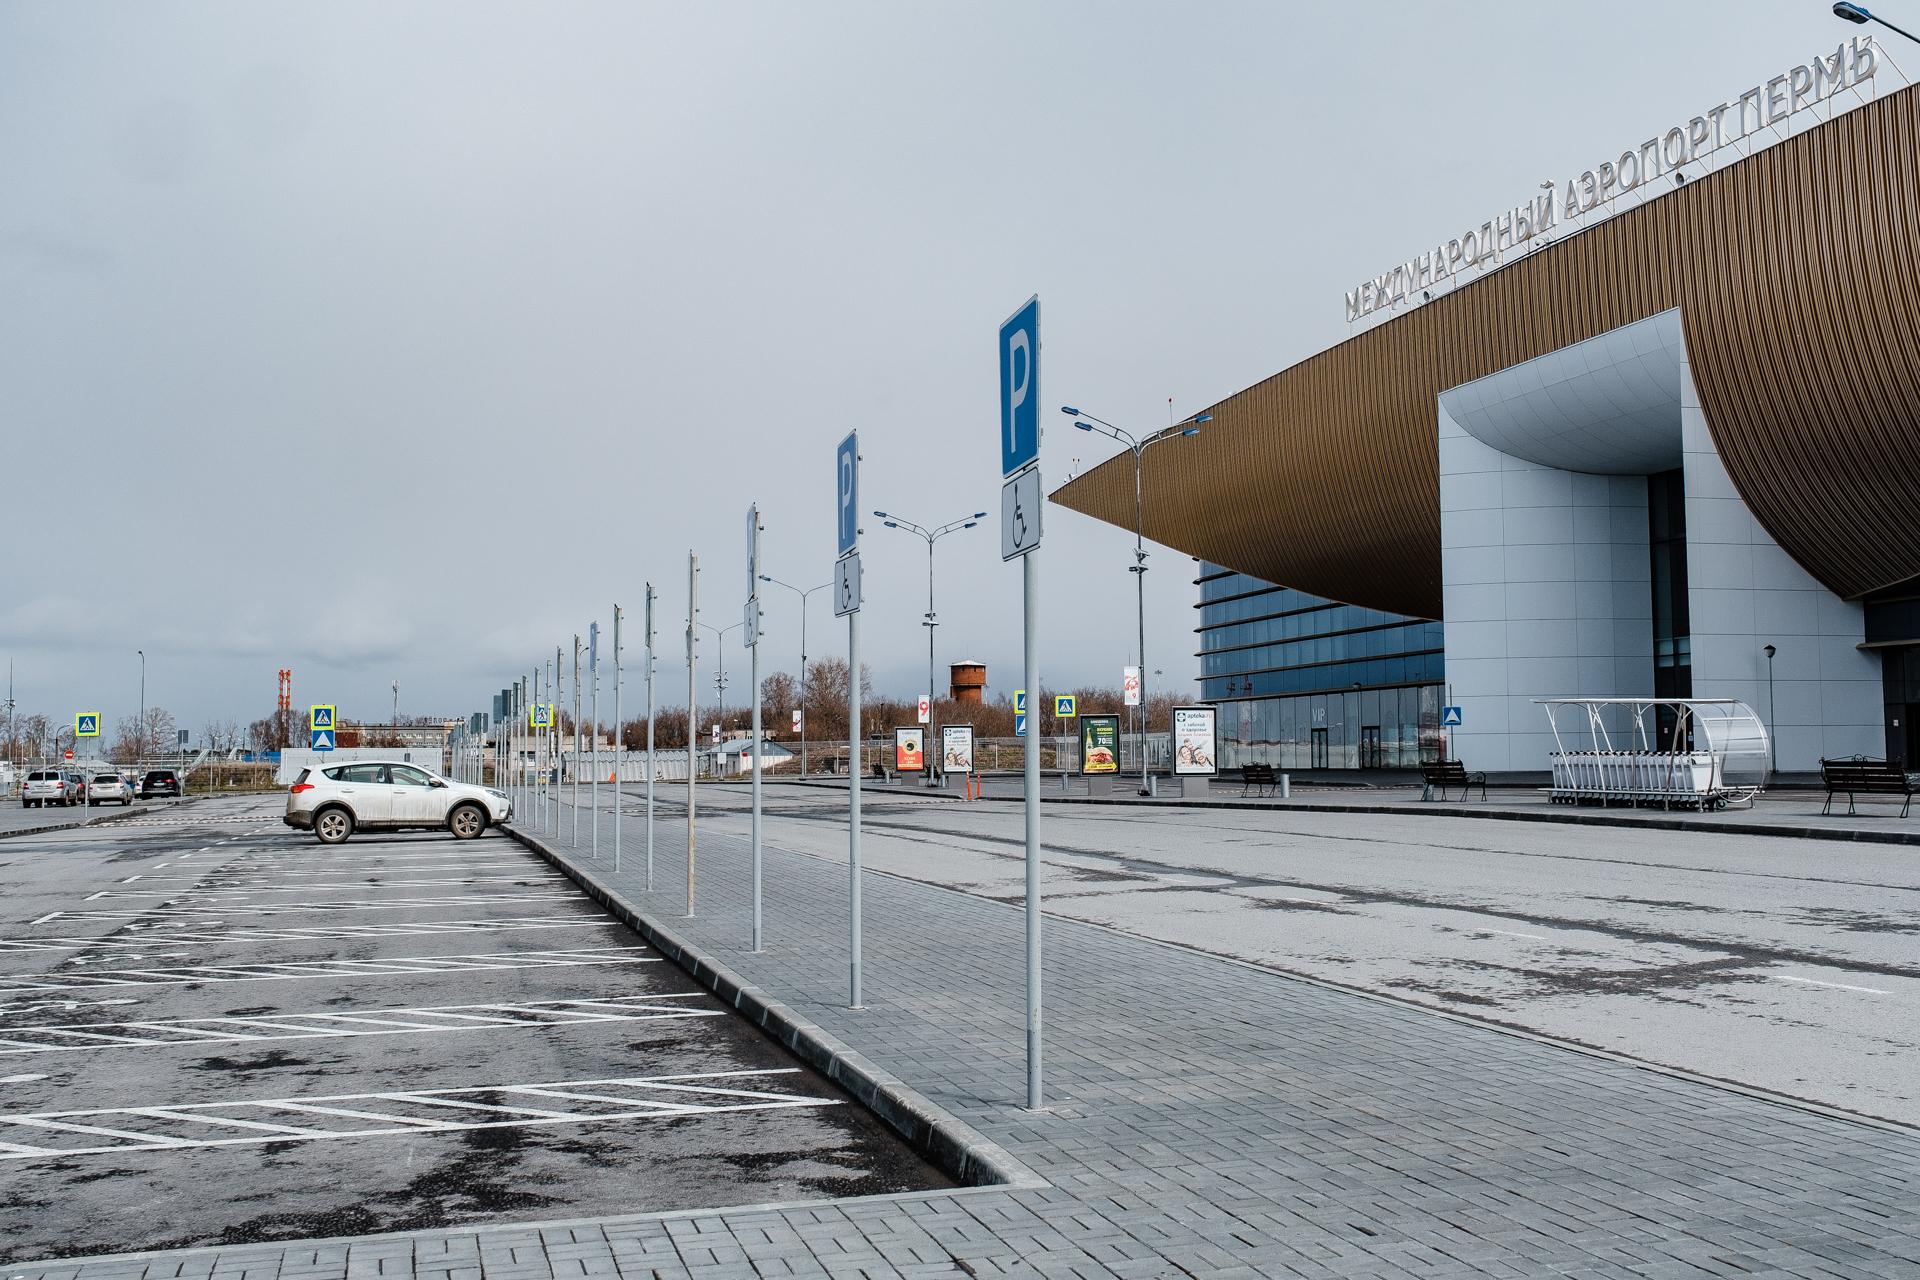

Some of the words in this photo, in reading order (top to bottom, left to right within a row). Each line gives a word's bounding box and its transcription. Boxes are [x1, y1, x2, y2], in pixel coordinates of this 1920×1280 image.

[1345, 180, 1559, 323] МЕЖДУНАРОДНЫЙ
[1564, 102, 1732, 219] АЭРОПОРТ
[1740, 35, 1879, 136] ПЕРМЬ
[1010, 328, 1030, 454] P
[842, 450, 852, 540] P
[1312, 707, 1325, 722] VIP
